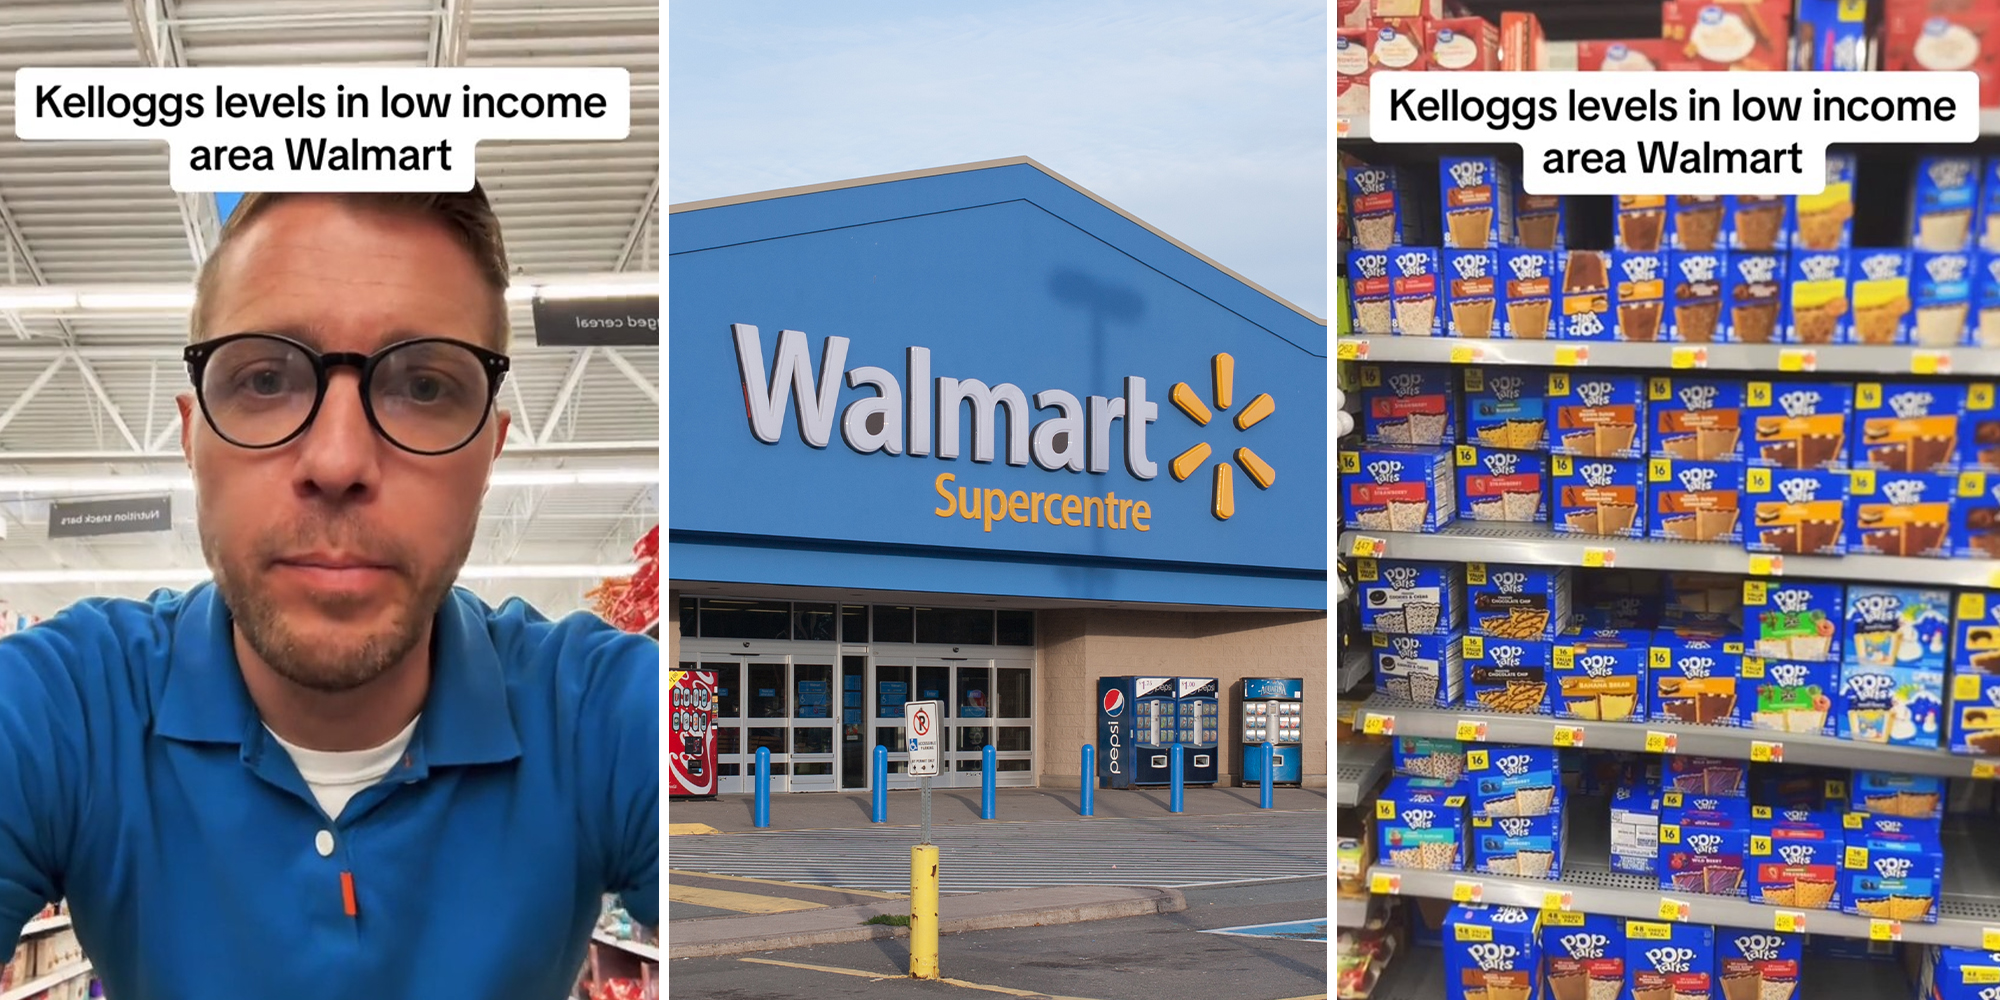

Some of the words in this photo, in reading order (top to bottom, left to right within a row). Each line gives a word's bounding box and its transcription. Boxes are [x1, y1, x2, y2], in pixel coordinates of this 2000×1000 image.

[1552, 379, 1564, 390] 16
[1654, 384, 1665, 395] 16
[731, 323, 1158, 480] Walmart
[1460, 450, 1472, 460] 16
[1343, 457, 1355, 468] 16
[1556, 459, 1567, 470] 16
[1654, 465, 1665, 476] 16
[934, 472, 1152, 533] Supercentre
[1654, 653, 1665, 663] 16
[1108, 721, 1121, 774] pepsi
[1471, 755, 1483, 765] 16
[1381, 805, 1390, 815] 16
[1664, 829, 1675, 839] 16
[1755, 840, 1766, 850] 16
